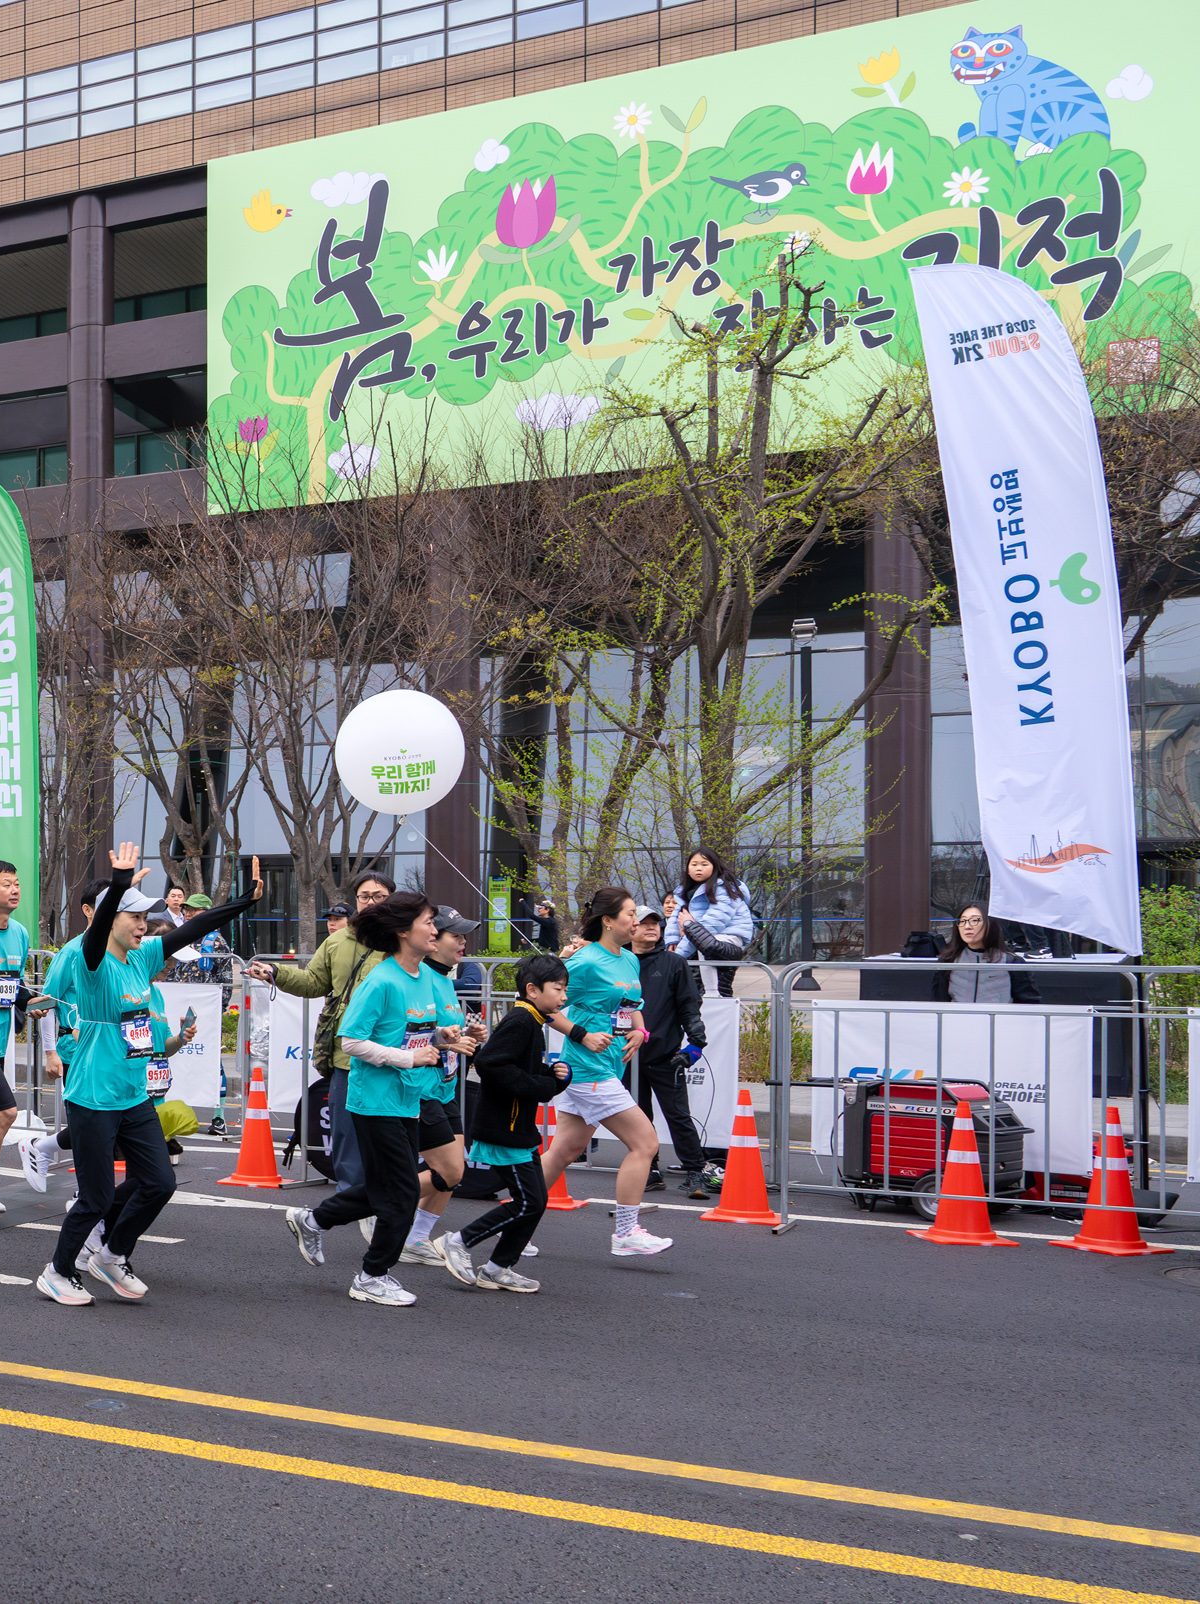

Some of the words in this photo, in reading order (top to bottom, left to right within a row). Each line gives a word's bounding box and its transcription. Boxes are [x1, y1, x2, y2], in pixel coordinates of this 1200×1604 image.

[274, 179, 436, 422] 봄,
[448, 298, 610, 379] 우리가
[607, 220, 737, 298] 가장
[371, 765, 403, 780] 우리
[405, 760, 436, 778] 함께
[378, 778, 431, 795] 끝까지!
[988, 1081, 1025, 1090] OREA
